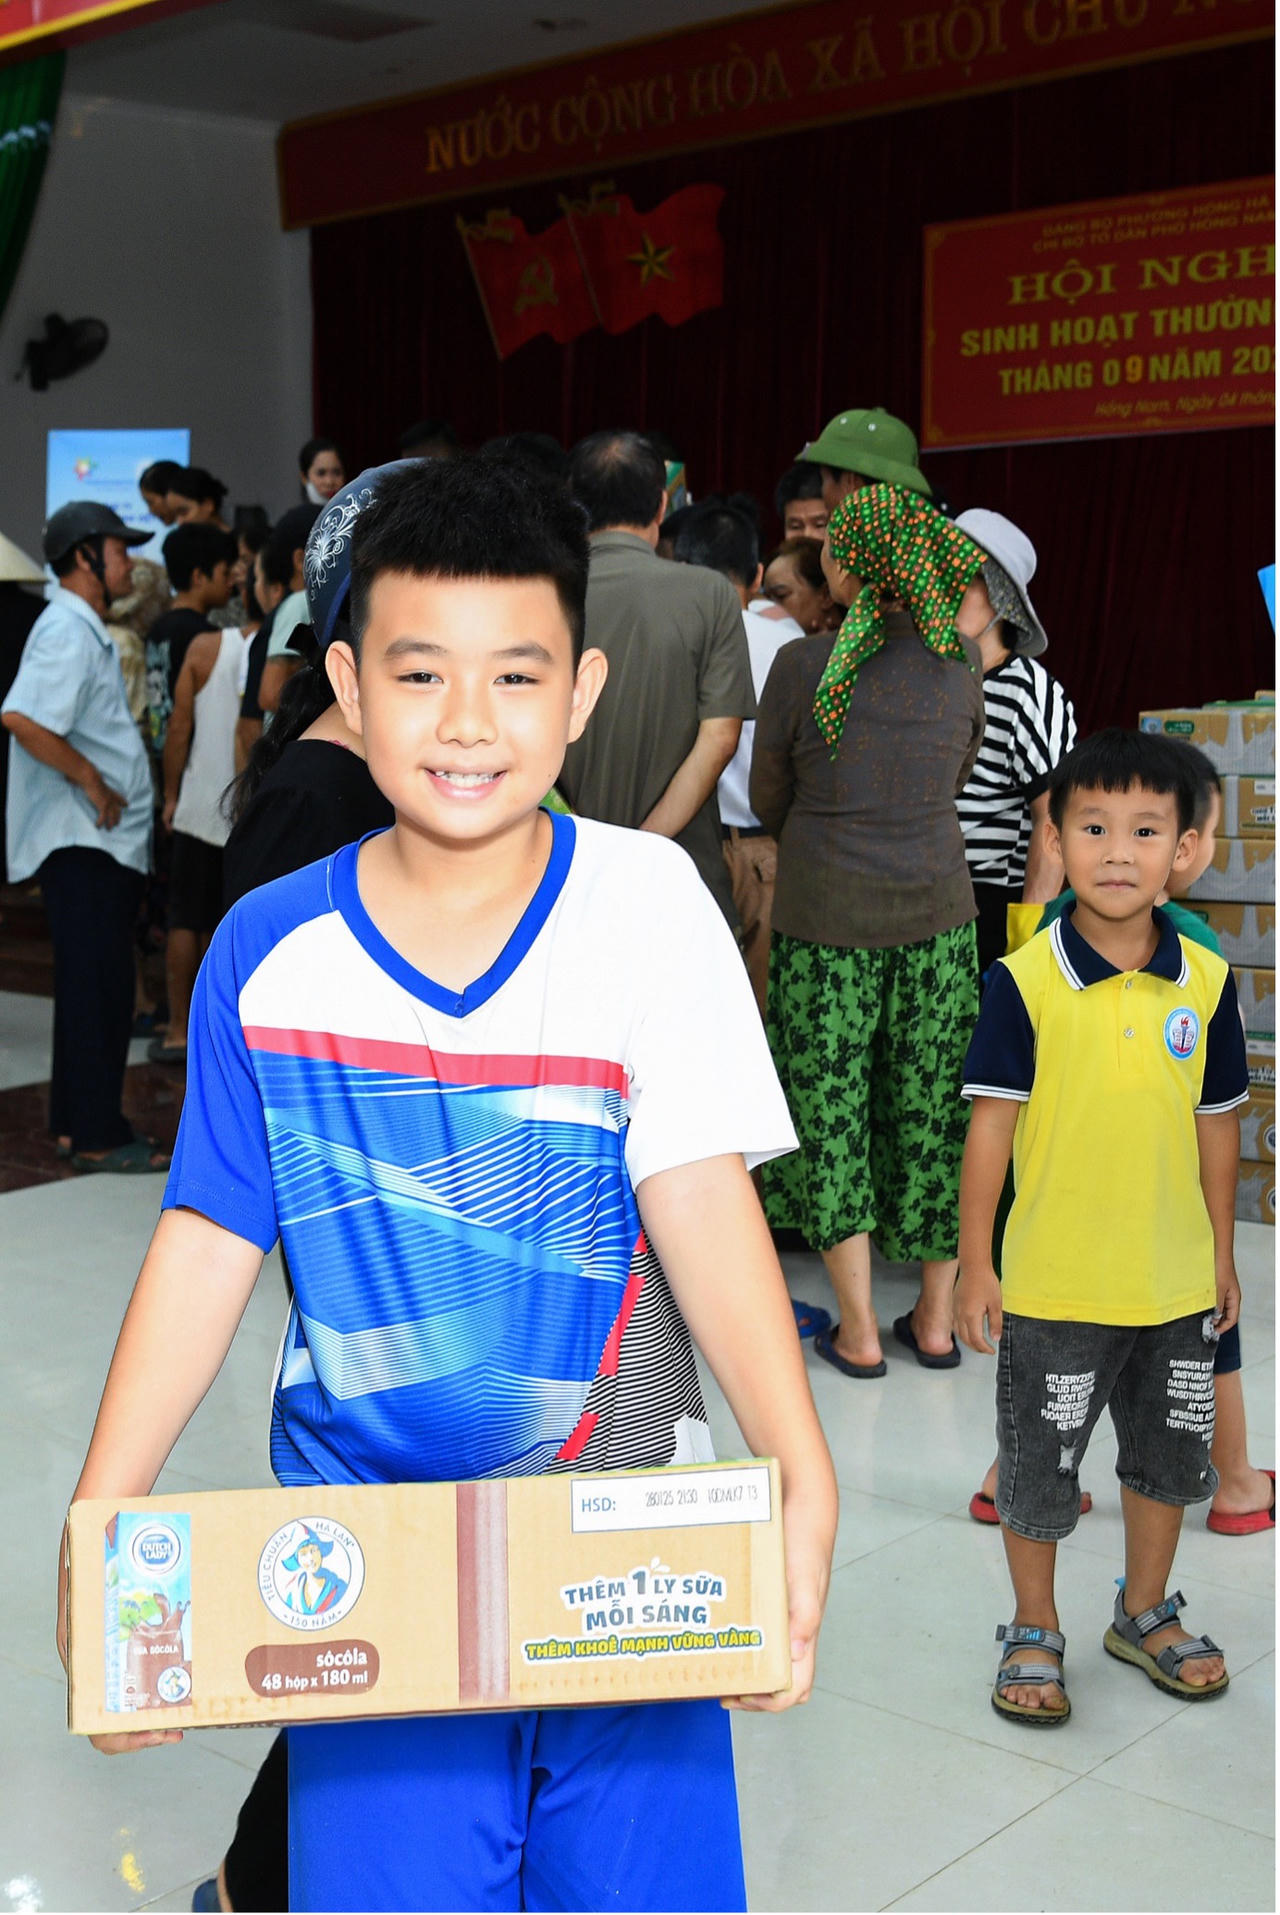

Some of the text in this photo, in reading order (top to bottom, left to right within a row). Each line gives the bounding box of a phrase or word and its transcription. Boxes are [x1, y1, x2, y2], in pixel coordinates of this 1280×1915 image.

[424, 93, 541, 174] NƯỚC
[550, 73, 677, 155] CỘNG
[688, 42, 794, 117] HÒA
[804, 14, 887, 97] XÃ
[1006, 257, 1118, 306] HỘI
[959, 322, 1040, 358] SINH
[1049, 311, 1140, 349] HOẠT
[997, 357, 1094, 396] THÁNG
[1146, 344, 1222, 382] NĂM
[1231, 343, 1275, 375] 20
[581, 1496, 617, 1513] HSD:
[564, 1571, 723, 1605] THÊM 1 LY SỮA
[585, 1598, 708, 1631] MỖI SÁNG
[316, 1647, 368, 1668] sôcôla
[526, 1639, 572, 1660] THÊM
[620, 1636, 670, 1657] MẠNH
[672, 1631, 715, 1651] VỮNG
[718, 1627, 762, 1647] VÀNG
[261, 1669, 368, 1692] 48 hộp x 180 ml
